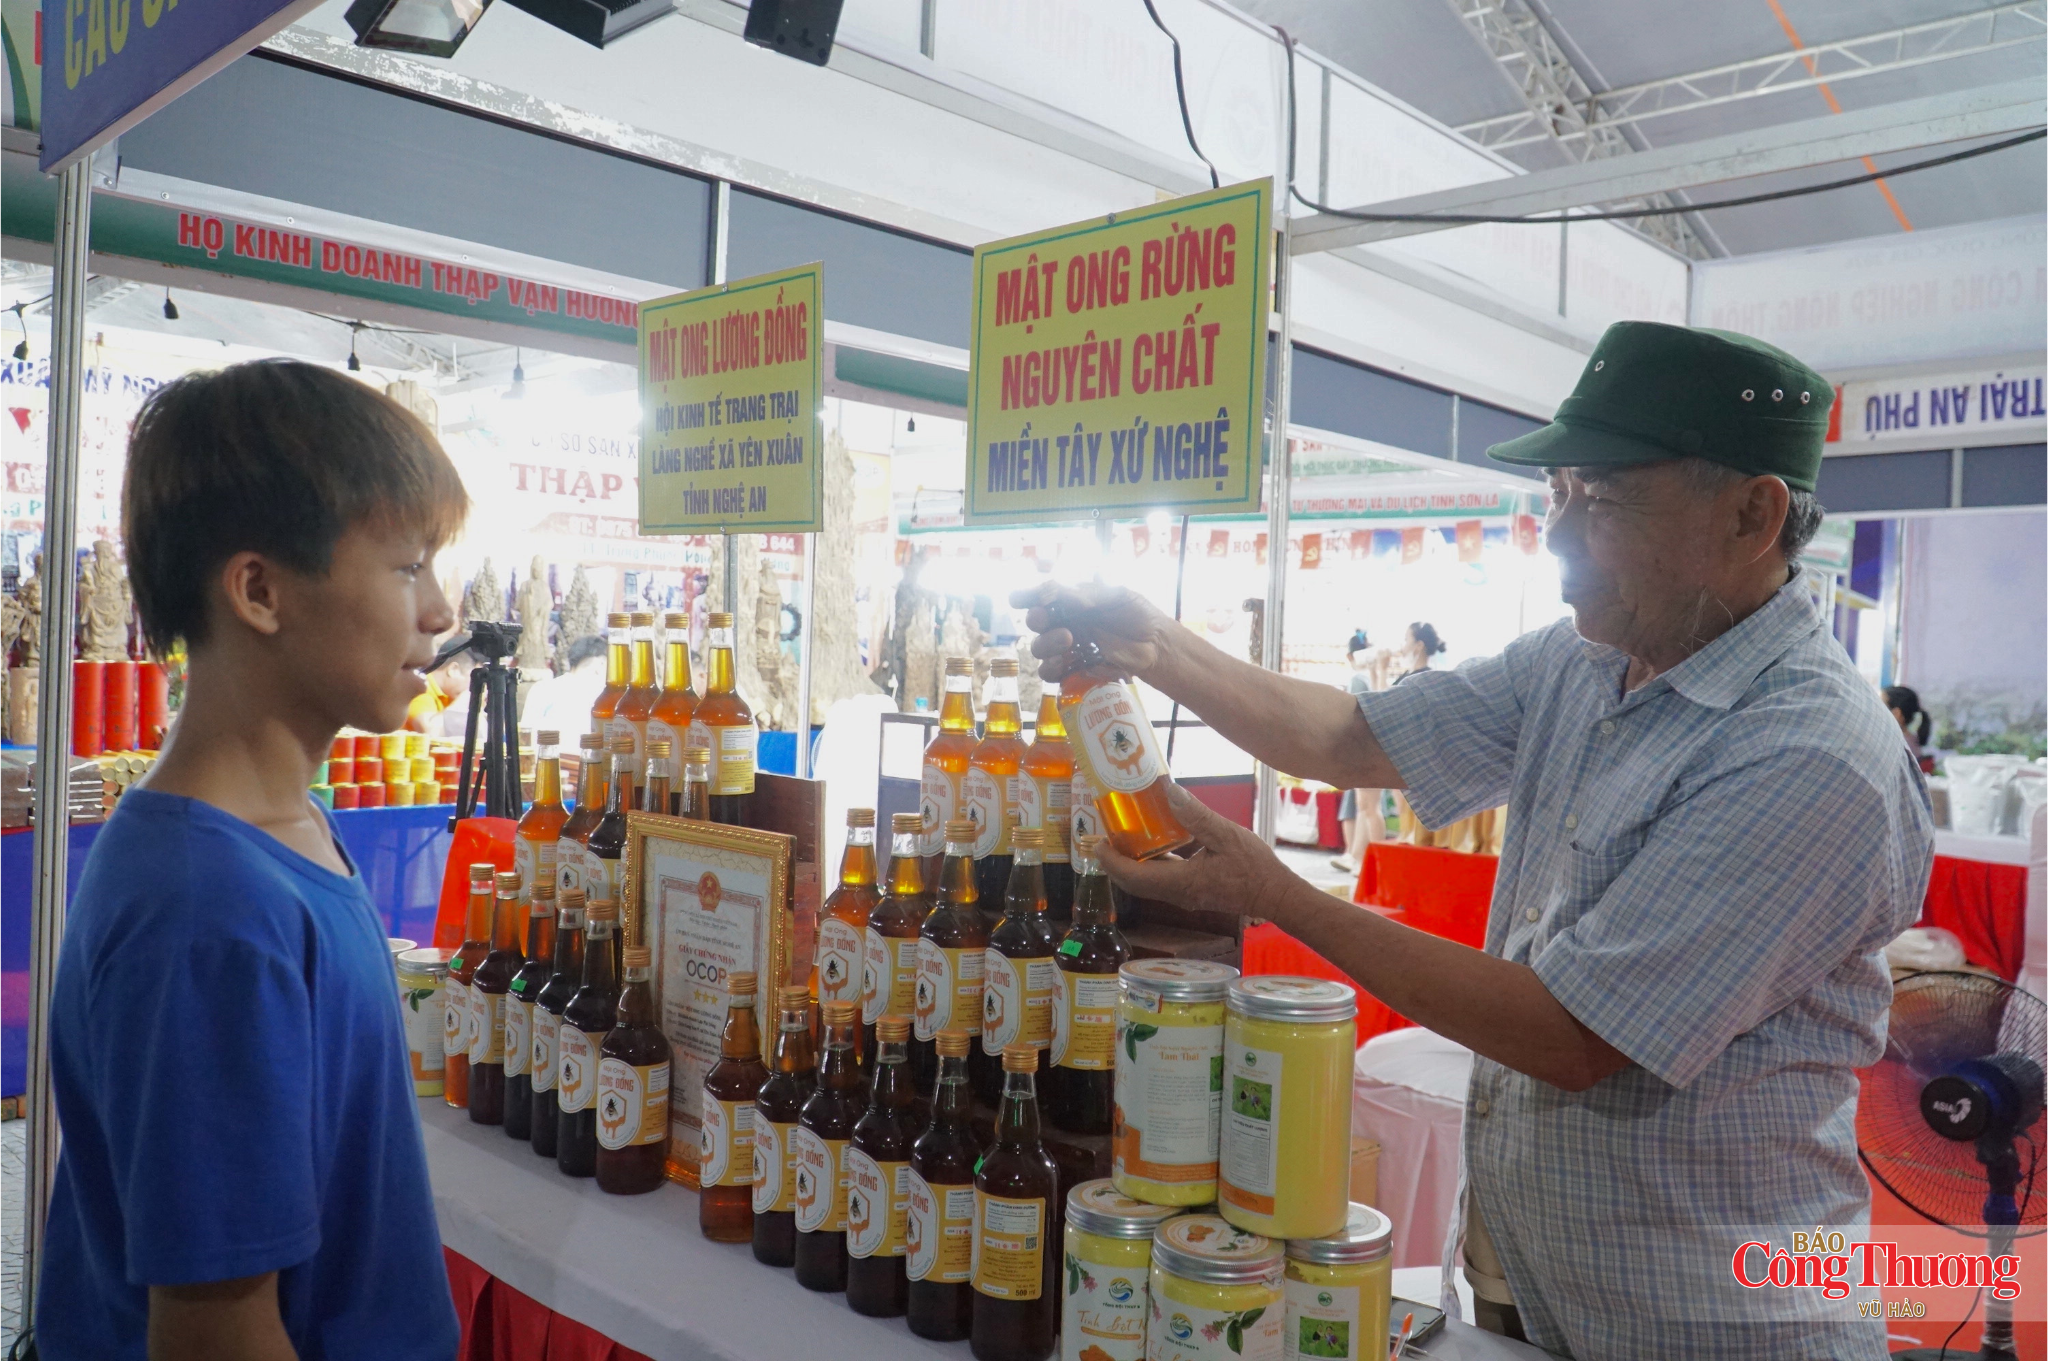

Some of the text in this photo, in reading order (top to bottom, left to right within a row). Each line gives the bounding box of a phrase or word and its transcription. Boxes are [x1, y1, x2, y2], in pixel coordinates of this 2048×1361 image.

[234, 223, 311, 269] KINH
[322, 240, 422, 289] DOANH
[995, 222, 1236, 334] MẬT ONG RỪNG
[650, 286, 807, 393] MẬT ONG LƯƠNG ĐỒNG
[1001, 303, 1220, 411] NGUYÊN CHẤT
[655, 390, 799, 437] HỘI KINH TẾ TRANG TRẠI
[1864, 371, 2046, 441] TRẠI AN PHÚ
[652, 444, 681, 474] LÀNG
[684, 437, 715, 472] NGHỀ
[718, 438, 735, 469] XÃ
[738, 436, 763, 468] YÊN
[766, 432, 804, 466] XUÂN
[987, 406, 1230, 493] MIỀN TÂY XỨ NGHỆ
[683, 481, 767, 519] TỈNH NGHỆ AN
[686, 959, 727, 985] OCOP
